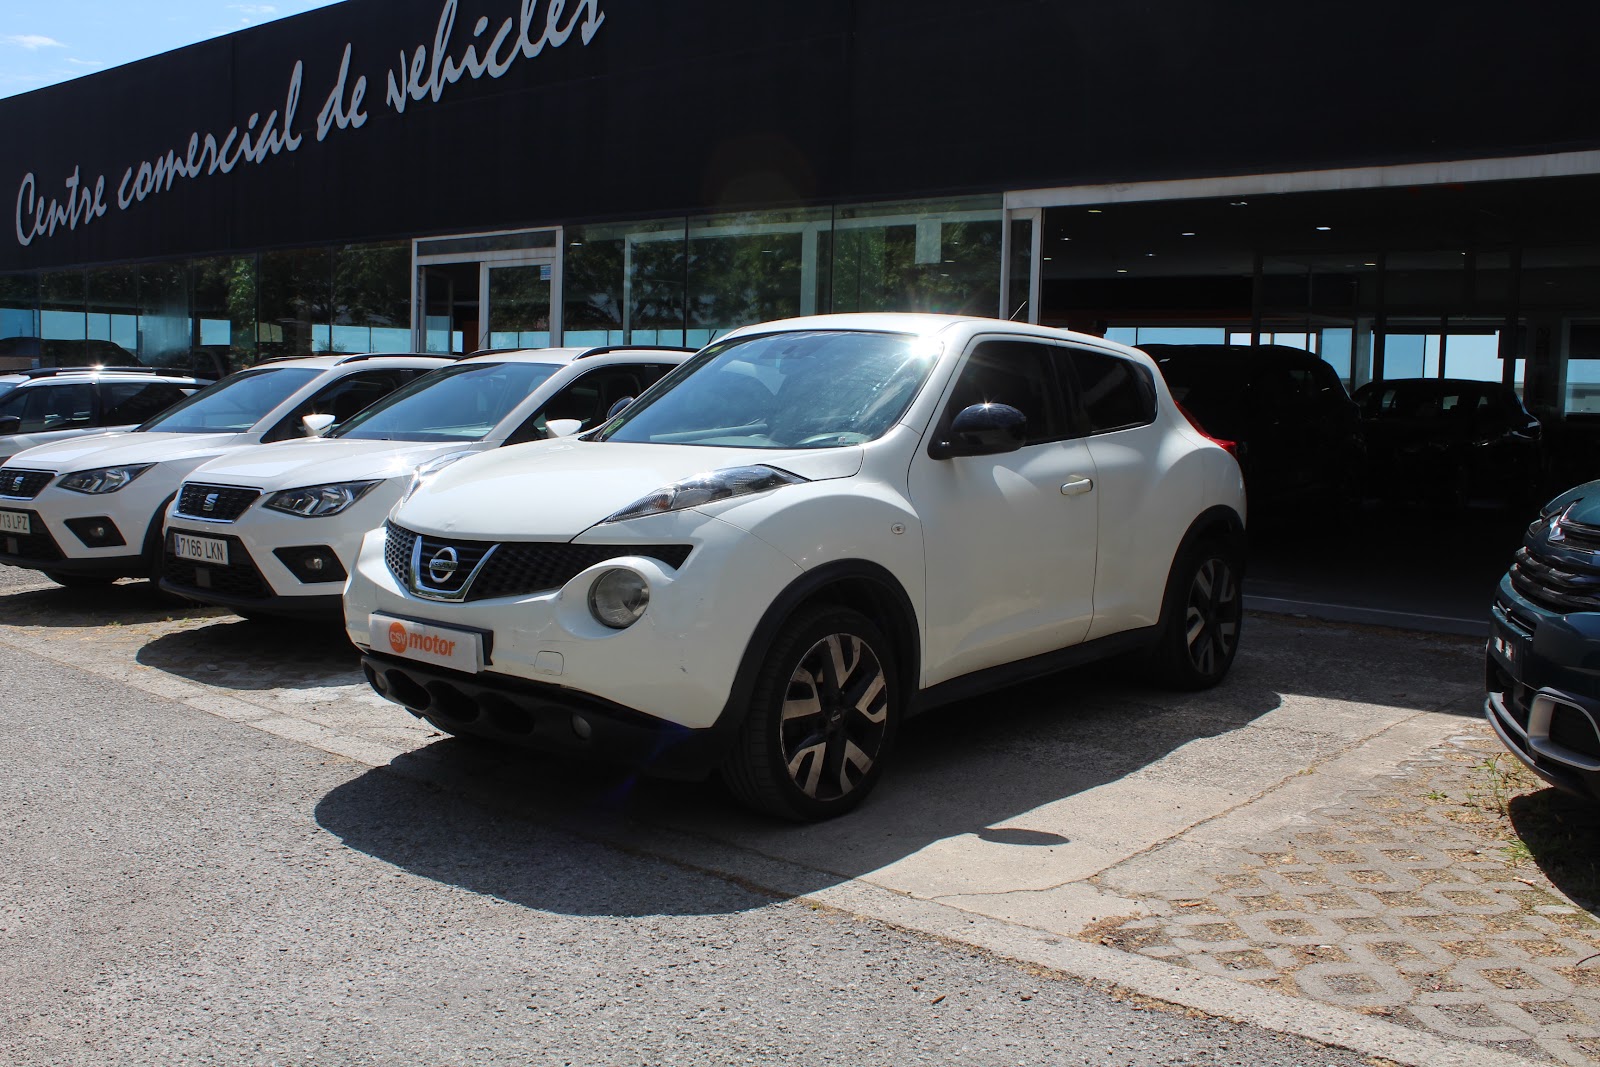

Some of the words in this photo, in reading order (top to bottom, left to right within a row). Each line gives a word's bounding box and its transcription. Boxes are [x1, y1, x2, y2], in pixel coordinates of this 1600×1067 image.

[16, 166, 106, 246] Centre
[118, 60, 302, 209] comercial
[317, 43, 367, 141] de
[386, 0, 605, 113] vehicles
[181, 538, 202, 557] 7166
[205, 541, 224, 560] LKN
[389, 631, 407, 644] CSV
[409, 632, 456, 656] motor
